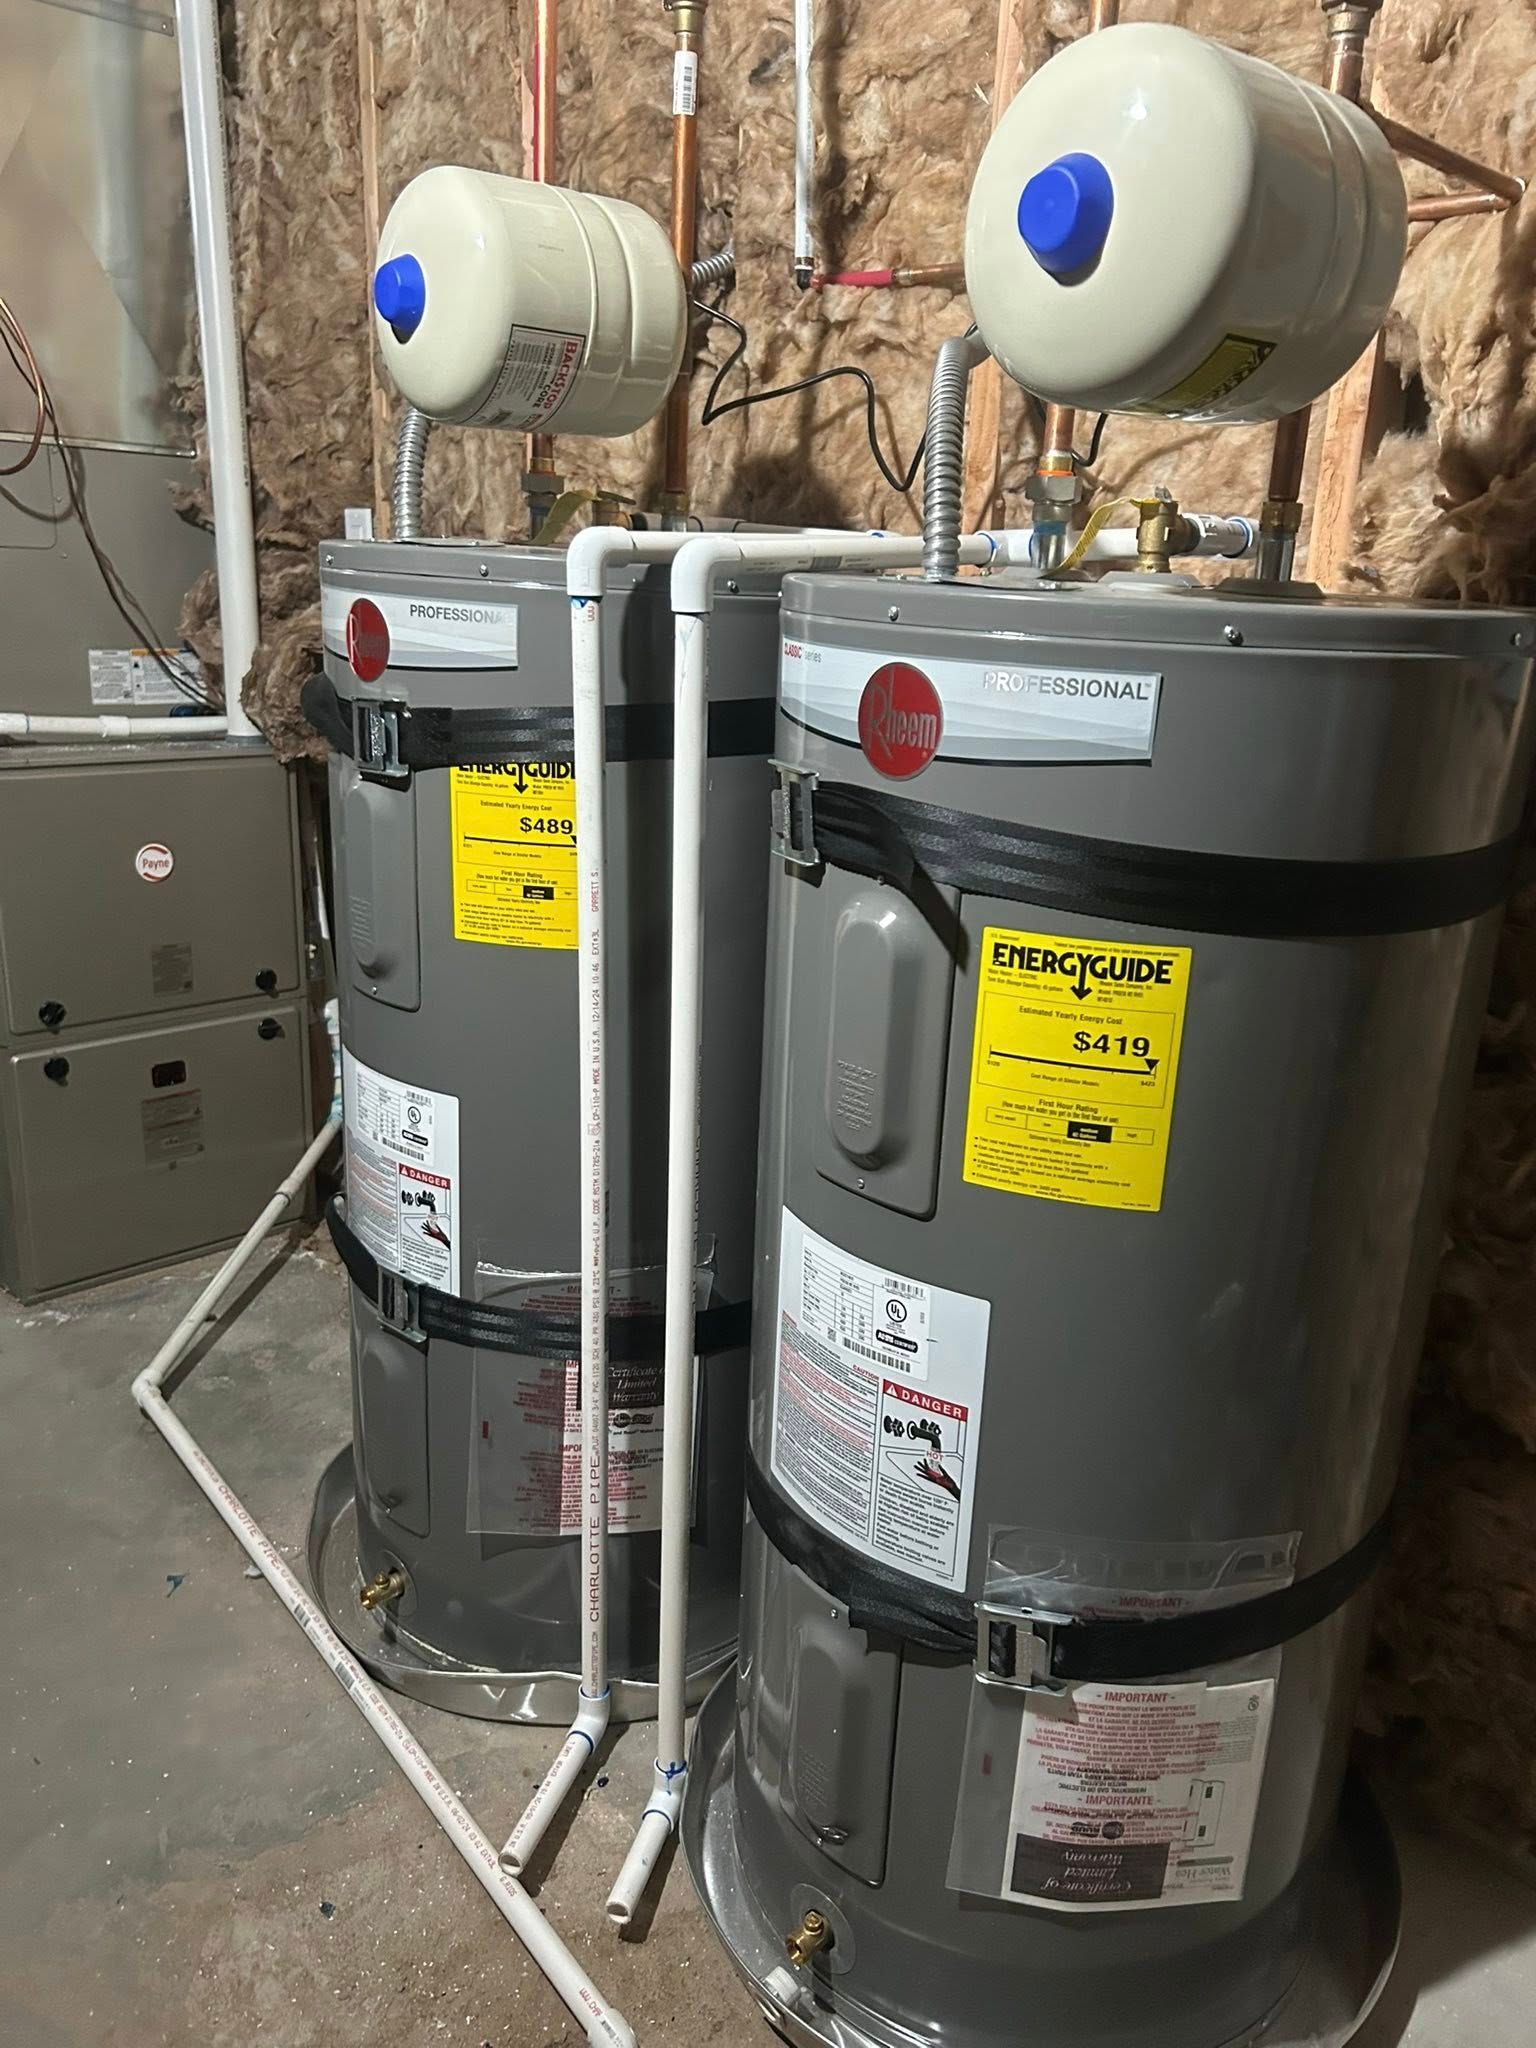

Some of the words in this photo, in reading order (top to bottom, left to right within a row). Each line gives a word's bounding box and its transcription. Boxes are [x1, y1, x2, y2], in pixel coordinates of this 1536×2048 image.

[544, 341, 579, 409] BACKSTOP
[982, 671, 1150, 701] PROFESSIONAL
[864, 663, 938, 760] Rheem
[519, 817, 573, 835] $489
[142, 858, 170, 871] Payne
[991, 941, 1175, 985] ENERGYGUIDE
[592, 989, 600, 1022] 12/14/24
[1019, 1005, 1054, 1018] Estimated
[1055, 1010, 1078, 1022] Yearly
[1079, 1013, 1105, 1025] Energy
[1106, 1016, 1123, 1025] Cost
[1072, 1030, 1150, 1057] $419
[1038, 1099, 1055, 1108] First
[1056, 1101, 1074, 1111] Hour
[1075, 1104, 1099, 1115] Rating
[410, 1169, 448, 1188] DANGER
[853, 1364, 880, 1380] CAUTION
[617, 1378, 657, 1389] Limited
[613, 1391, 658, 1402] Warranty
[902, 1389, 962, 1418] DANGER
[926, 1450, 945, 1461] HOT
[589, 1455, 601, 1504] PIPE
[216, 1482, 260, 1538] CHARLOTTE
[256, 1537, 282, 1567] PIPE
[589, 1516, 600, 1622] CHARLOTTE
[1119, 1595, 1182, 1609] IMPORTANT
[1104, 1691, 1169, 1704] IMPORTANT
[1085, 1794, 1155, 1806] IMPORTANTE
[1060, 1848, 1124, 1867] Warranty
[1064, 1866, 1118, 1880] Limited
[1040, 1877, 1059, 1892] of
[1063, 1879, 1132, 1895] Certificate
